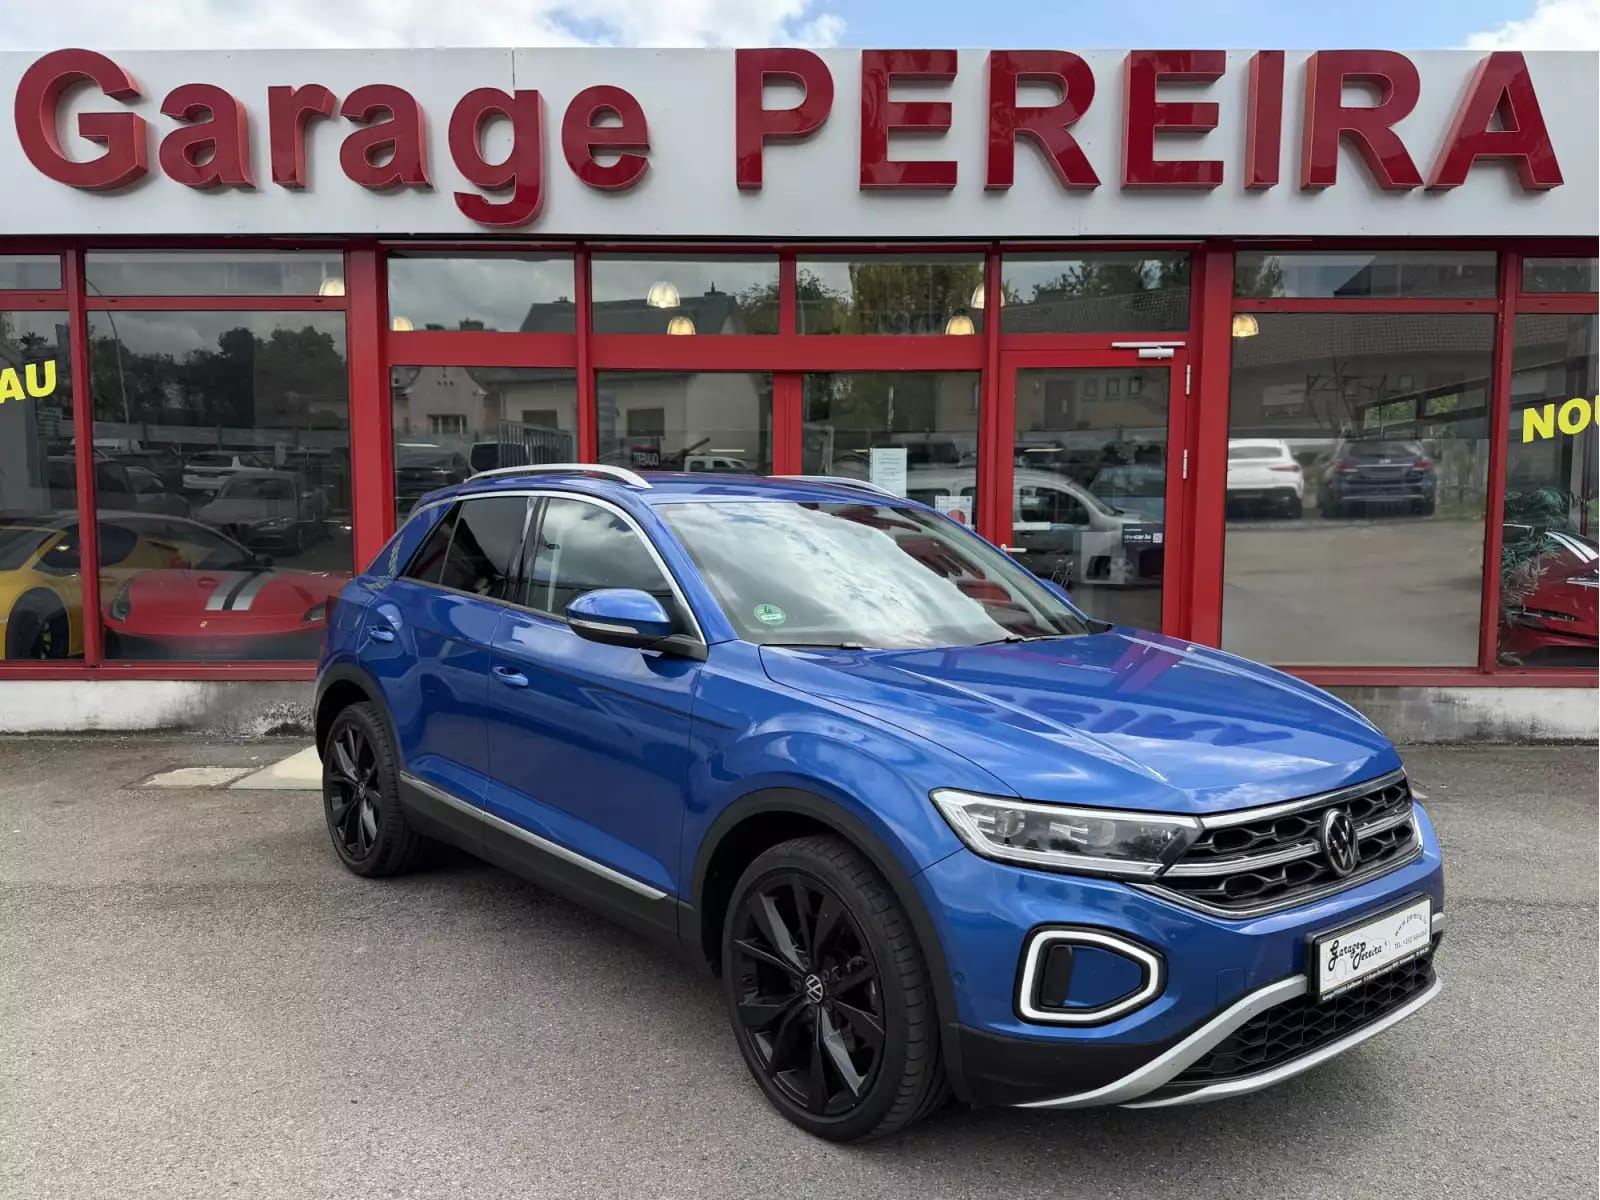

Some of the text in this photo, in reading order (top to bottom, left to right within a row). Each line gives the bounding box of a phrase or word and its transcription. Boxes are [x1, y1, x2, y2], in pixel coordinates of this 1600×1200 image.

[14, 48, 1564, 227] Garage PEREIRA
[1522, 394, 1599, 445] NO
